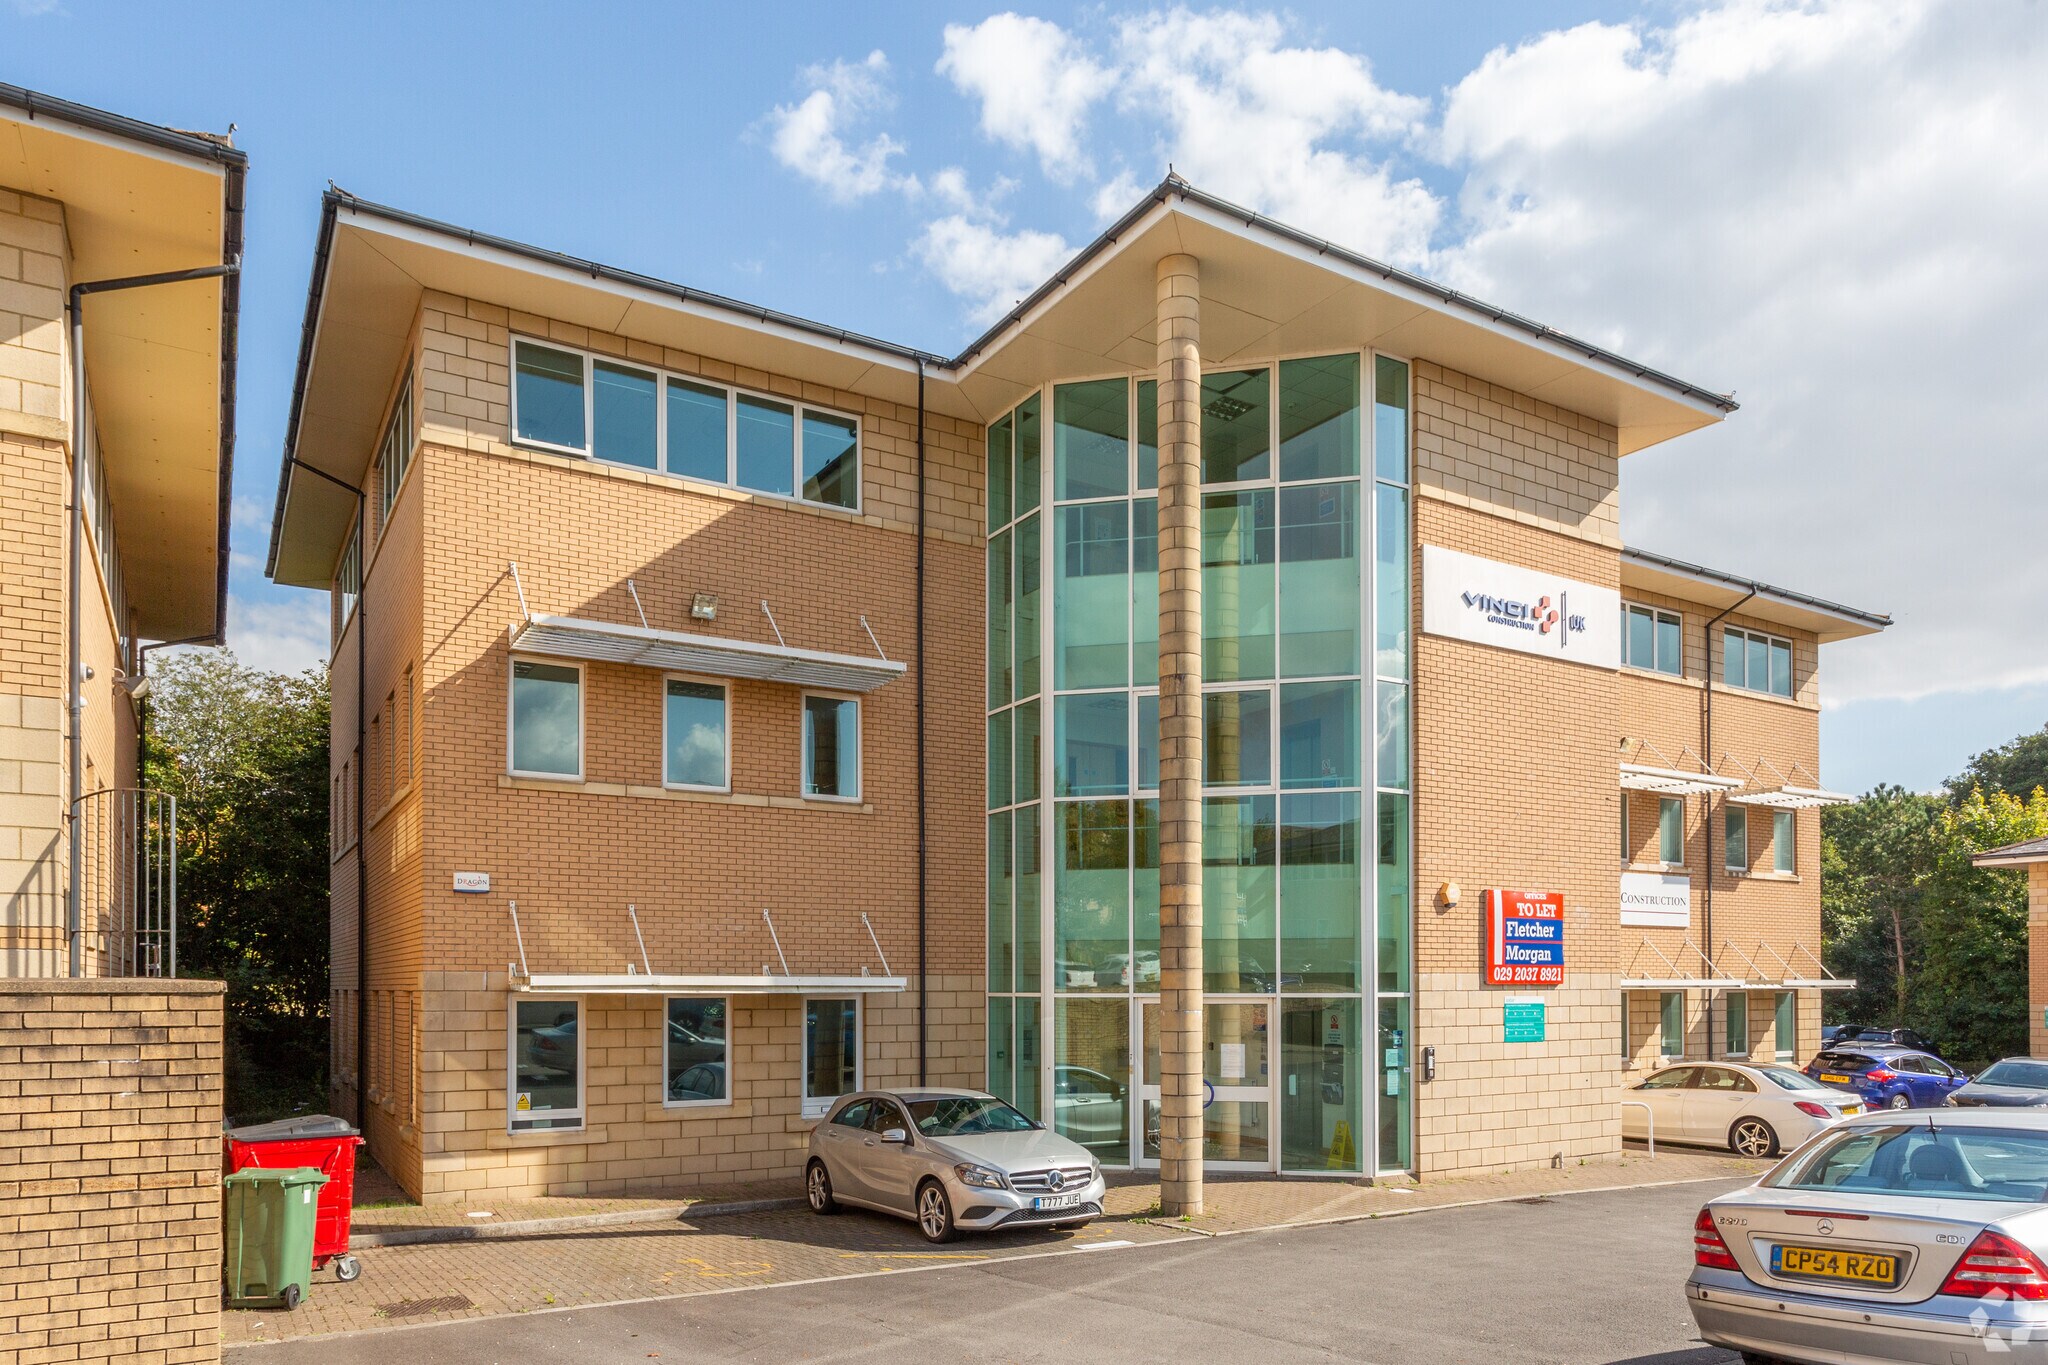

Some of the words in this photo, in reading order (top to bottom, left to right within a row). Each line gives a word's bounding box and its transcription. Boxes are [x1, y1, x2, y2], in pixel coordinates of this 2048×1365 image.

[1461, 591, 1529, 619] VINCI
[1487, 614, 1535, 631] CONSTRUCTION
[1569, 615, 1586, 632] UK
[1524, 892, 1547, 900] OFFICES
[1516, 903, 1534, 916] TO
[1535, 904, 1557, 917] LET
[1506, 921, 1555, 937] Fletcher
[1505, 945, 1552, 964] Morgan
[1494, 967, 1512, 981] 029
[1514, 967, 1538, 981] 2037
[1540, 967, 1562, 981] 8921
[1041, 1197, 1063, 1207] T777
[1065, 1194, 1079, 1205] JUE
[1936, 1234, 1966, 1244] CDI
[1786, 1250, 1839, 1273] CP54
[1846, 1256, 1890, 1279] RZO
